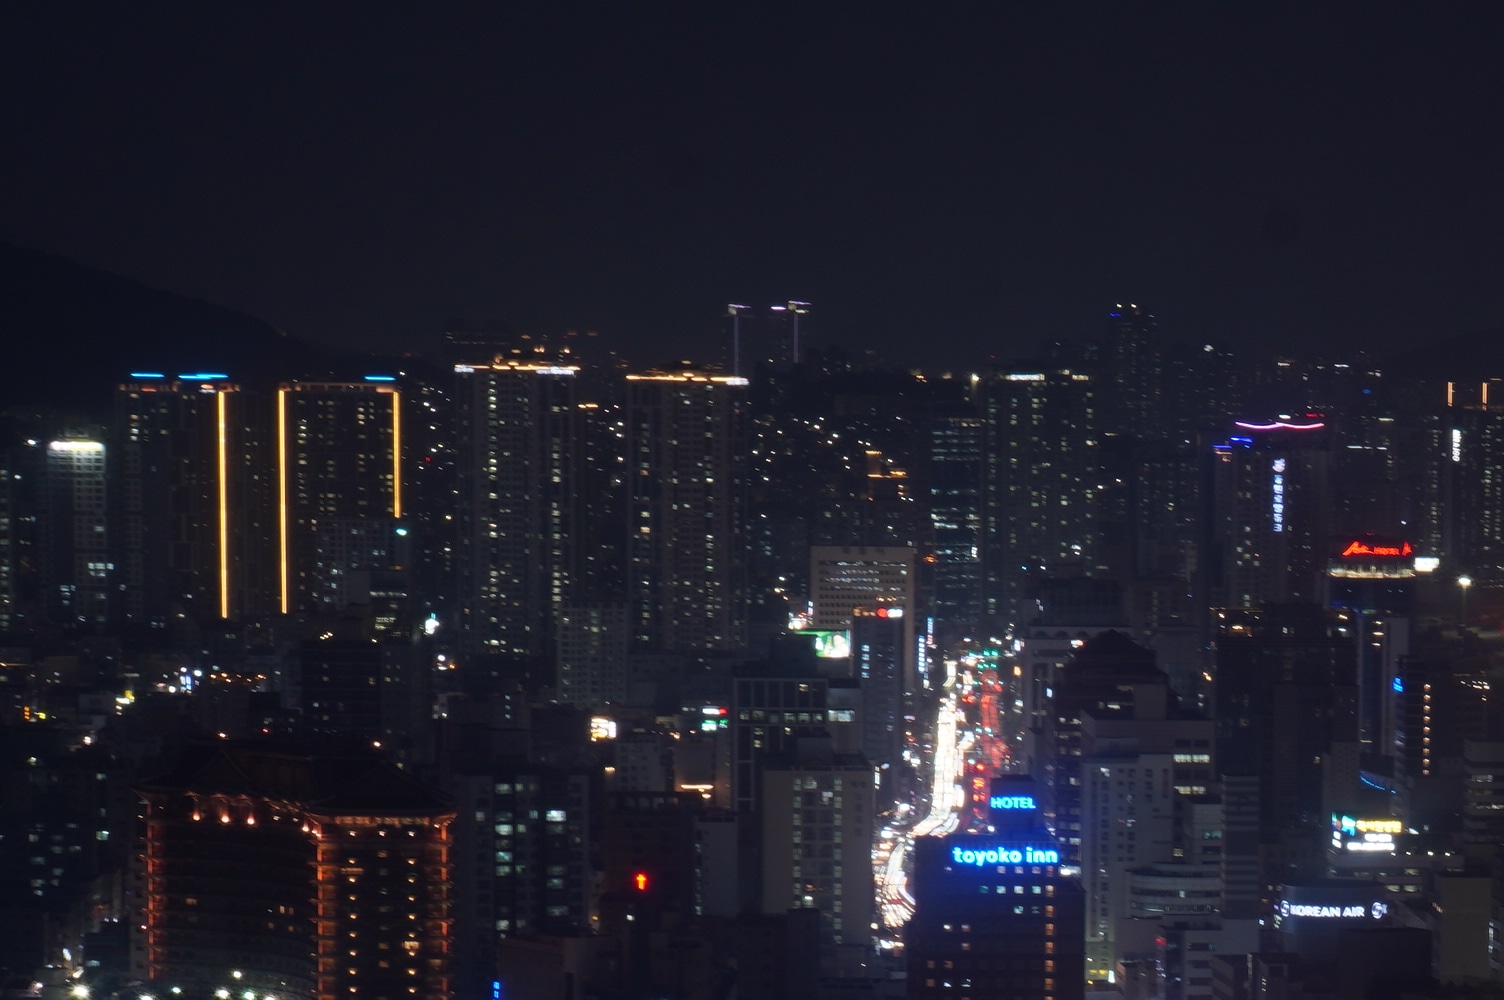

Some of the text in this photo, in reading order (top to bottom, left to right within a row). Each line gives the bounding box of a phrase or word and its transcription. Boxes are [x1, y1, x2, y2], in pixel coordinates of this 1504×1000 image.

[990, 796, 1036, 809] HOTEL
[953, 847, 1058, 866] toyoko inn
[1290, 904, 1365, 918] KOREAN AIR
